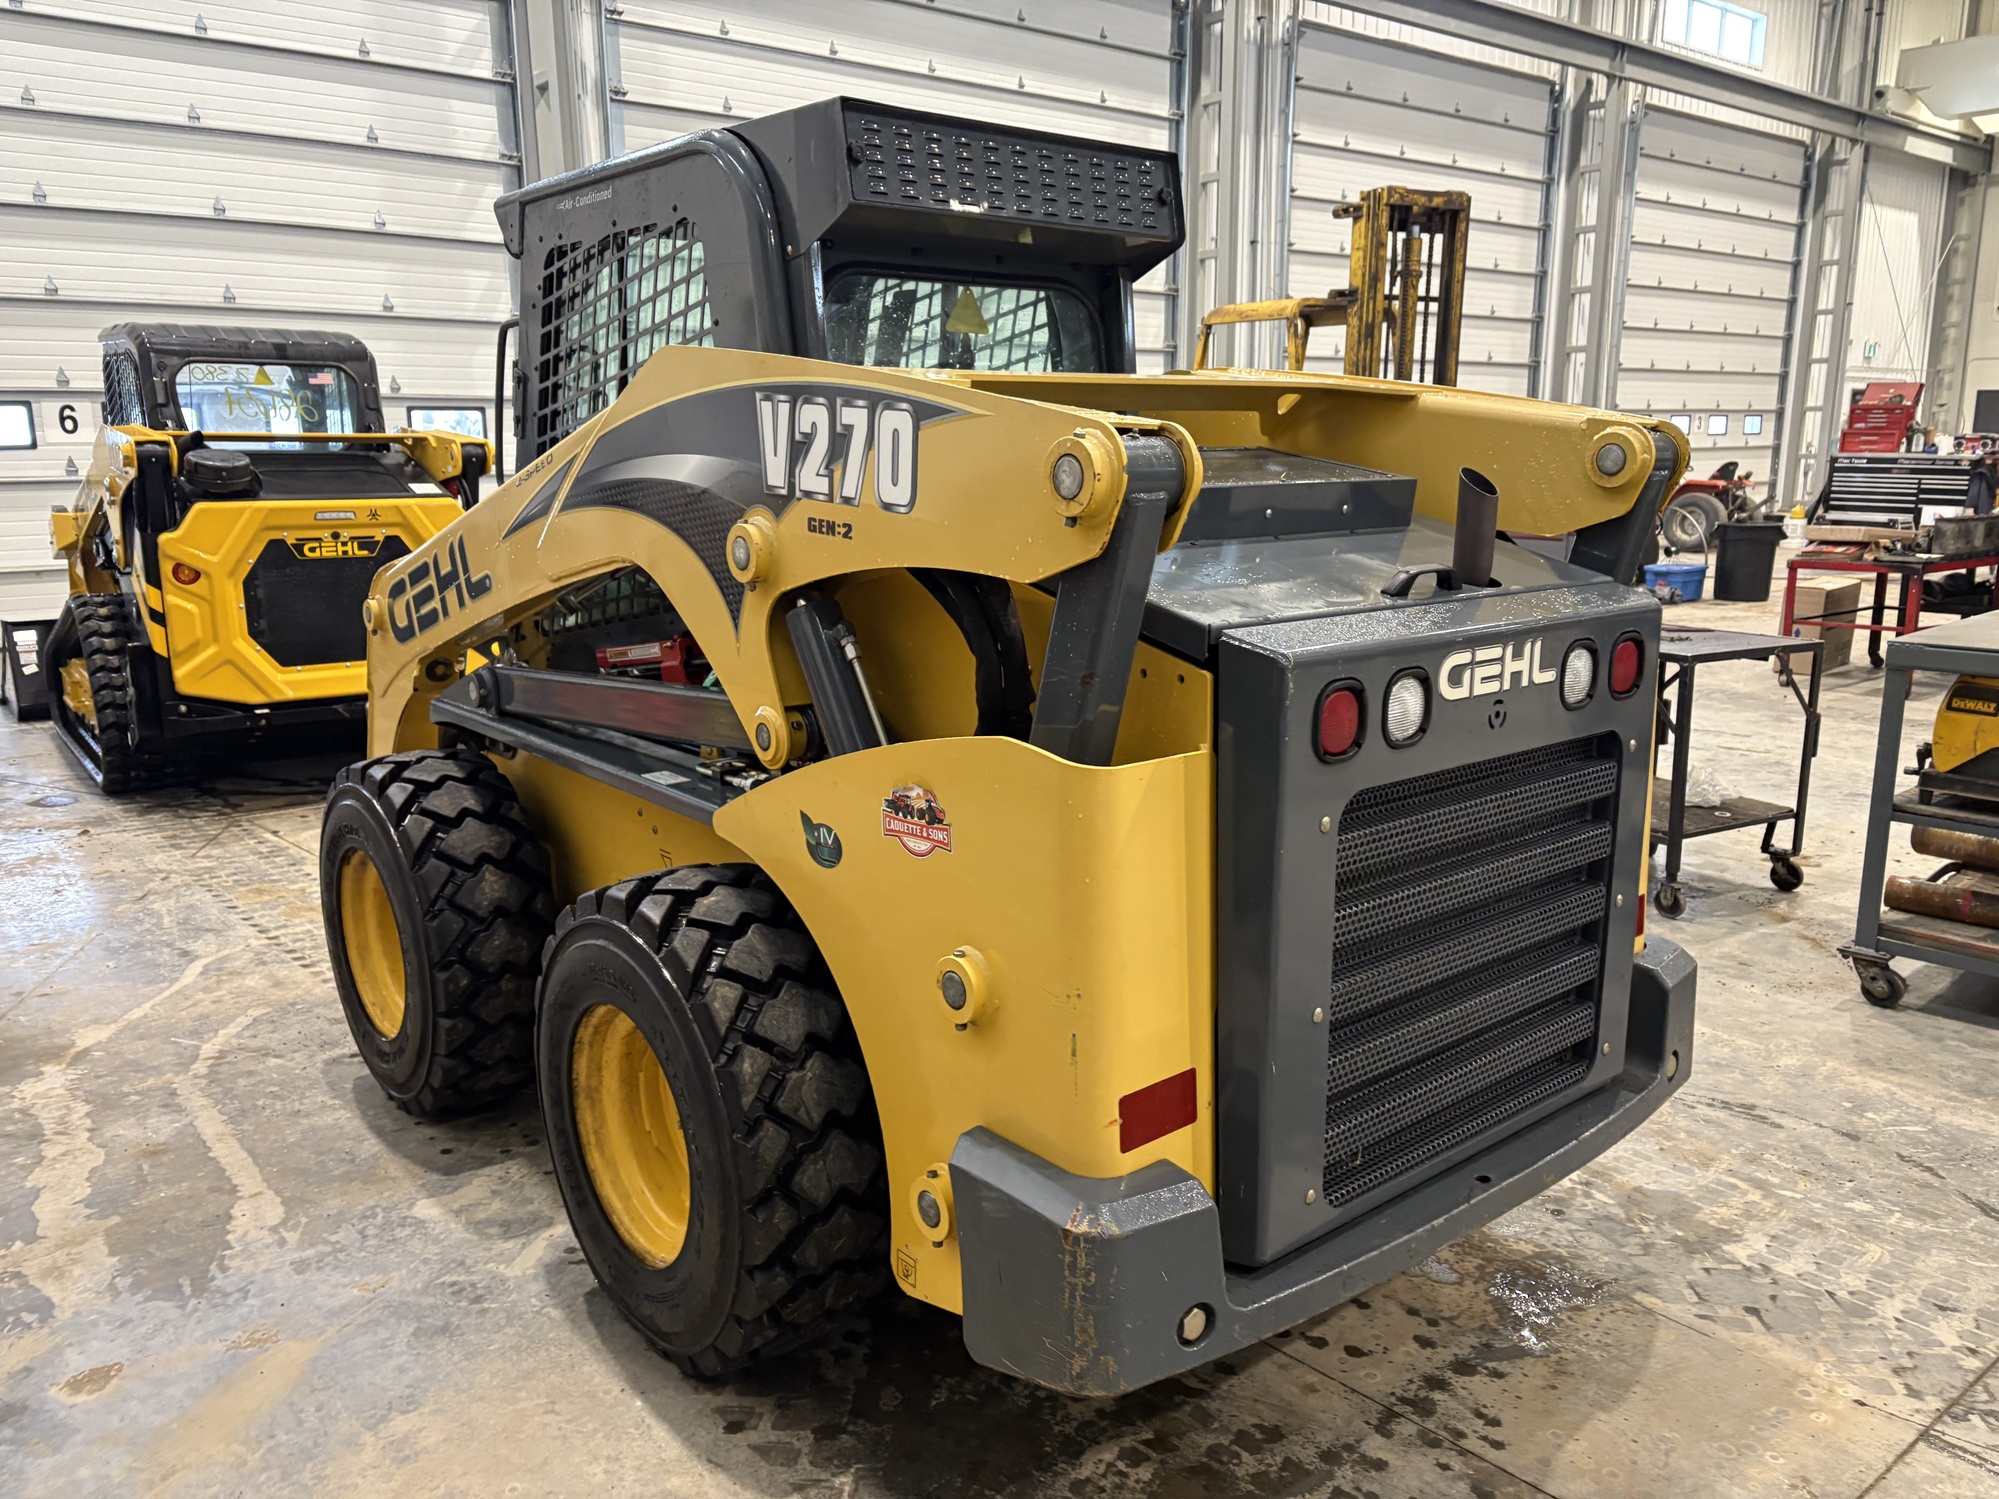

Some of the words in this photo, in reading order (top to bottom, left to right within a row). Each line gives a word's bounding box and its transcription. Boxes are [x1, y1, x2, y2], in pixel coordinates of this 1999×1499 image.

[564, 186, 612, 210] Air-Conditioned
[58, 404, 79, 434] 6
[1696, 415, 1703, 430] 3
[755, 391, 919, 514] V270
[807, 516, 853, 540] GEN:2
[303, 541, 370, 557] GEHL
[387, 530, 493, 644] GEHL
[1438, 637, 1558, 701] GEHL
[820, 827, 835, 845] IV
[922, 827, 928, 838] &
[928, 828, 948, 843] SONS
